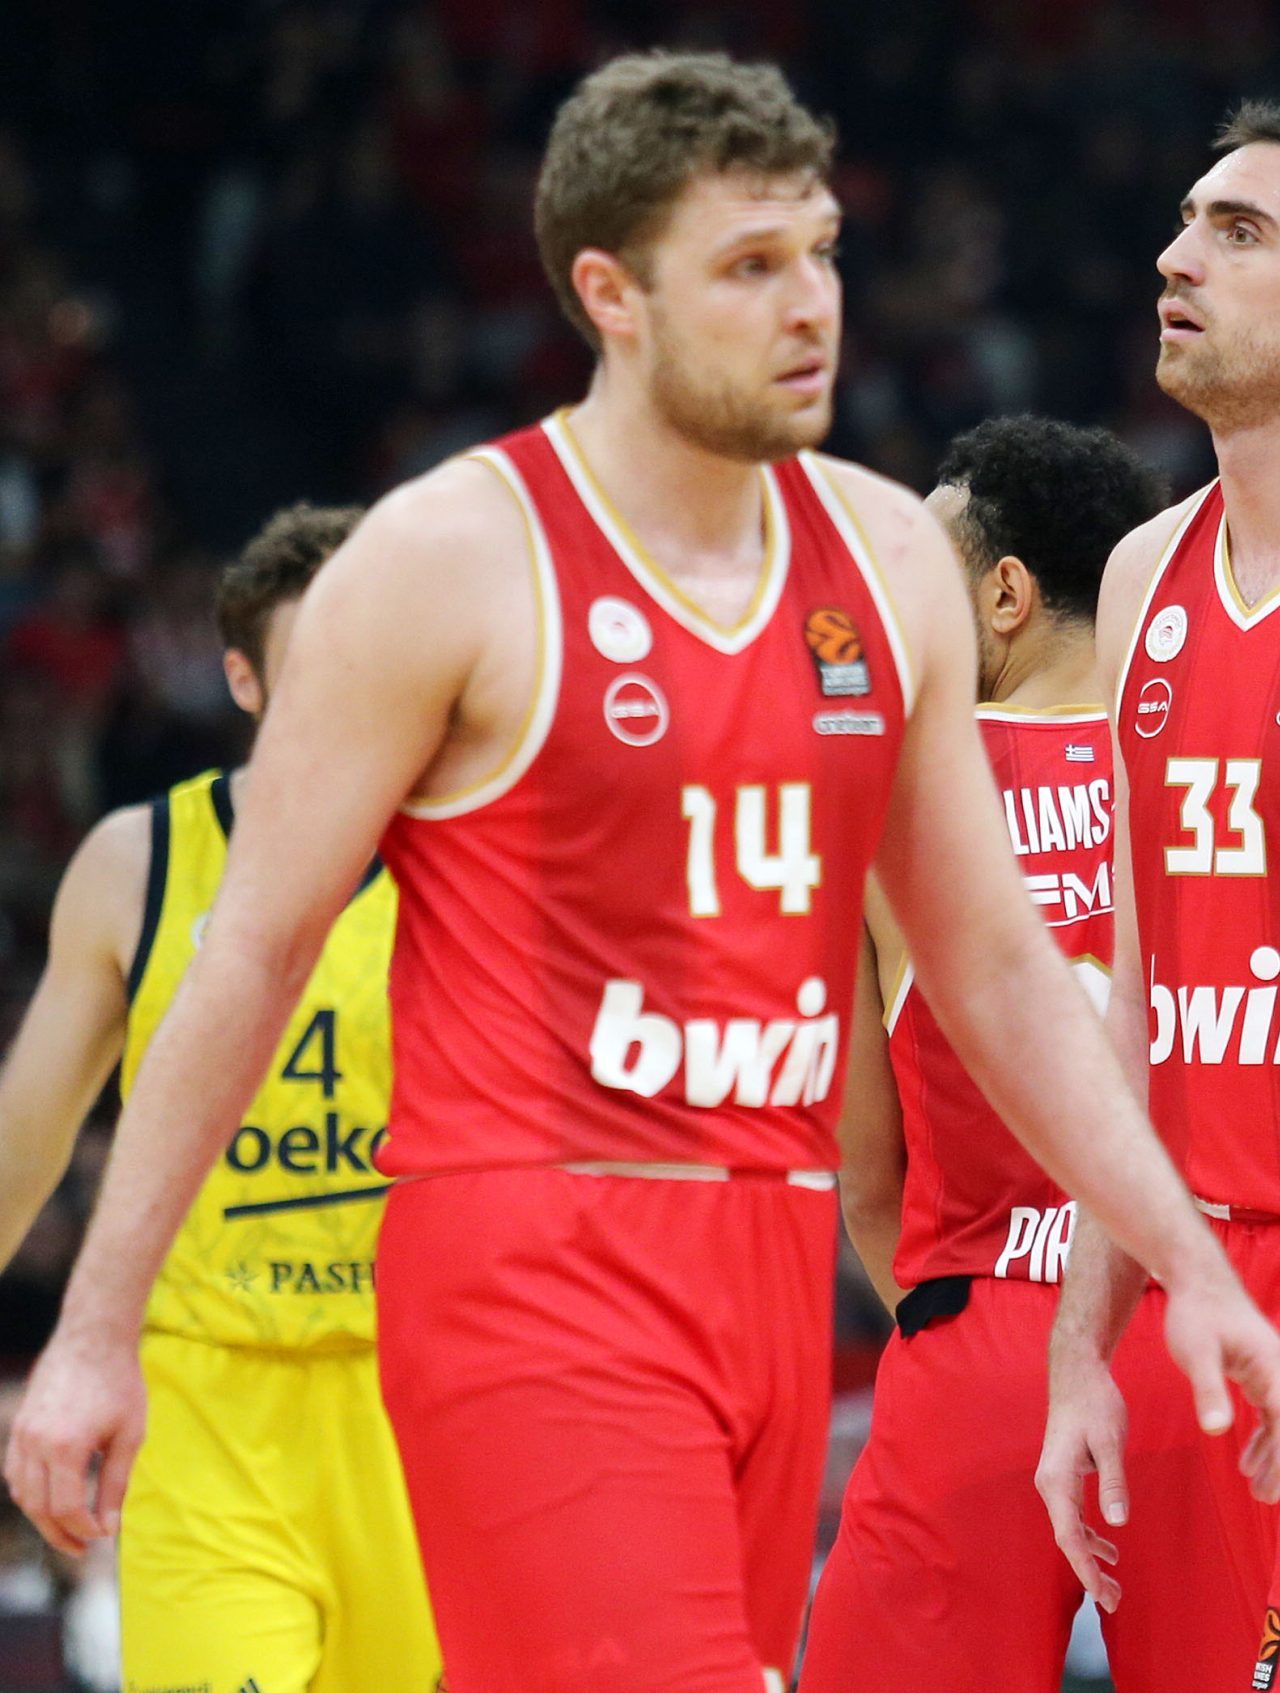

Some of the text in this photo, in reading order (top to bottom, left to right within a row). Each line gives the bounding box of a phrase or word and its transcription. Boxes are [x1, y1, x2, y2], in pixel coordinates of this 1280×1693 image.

[681, 781, 822, 918] 14
[1164, 757, 1267, 877] 33
[281, 1009, 343, 1098] 4
[590, 976, 838, 1108] bwin
